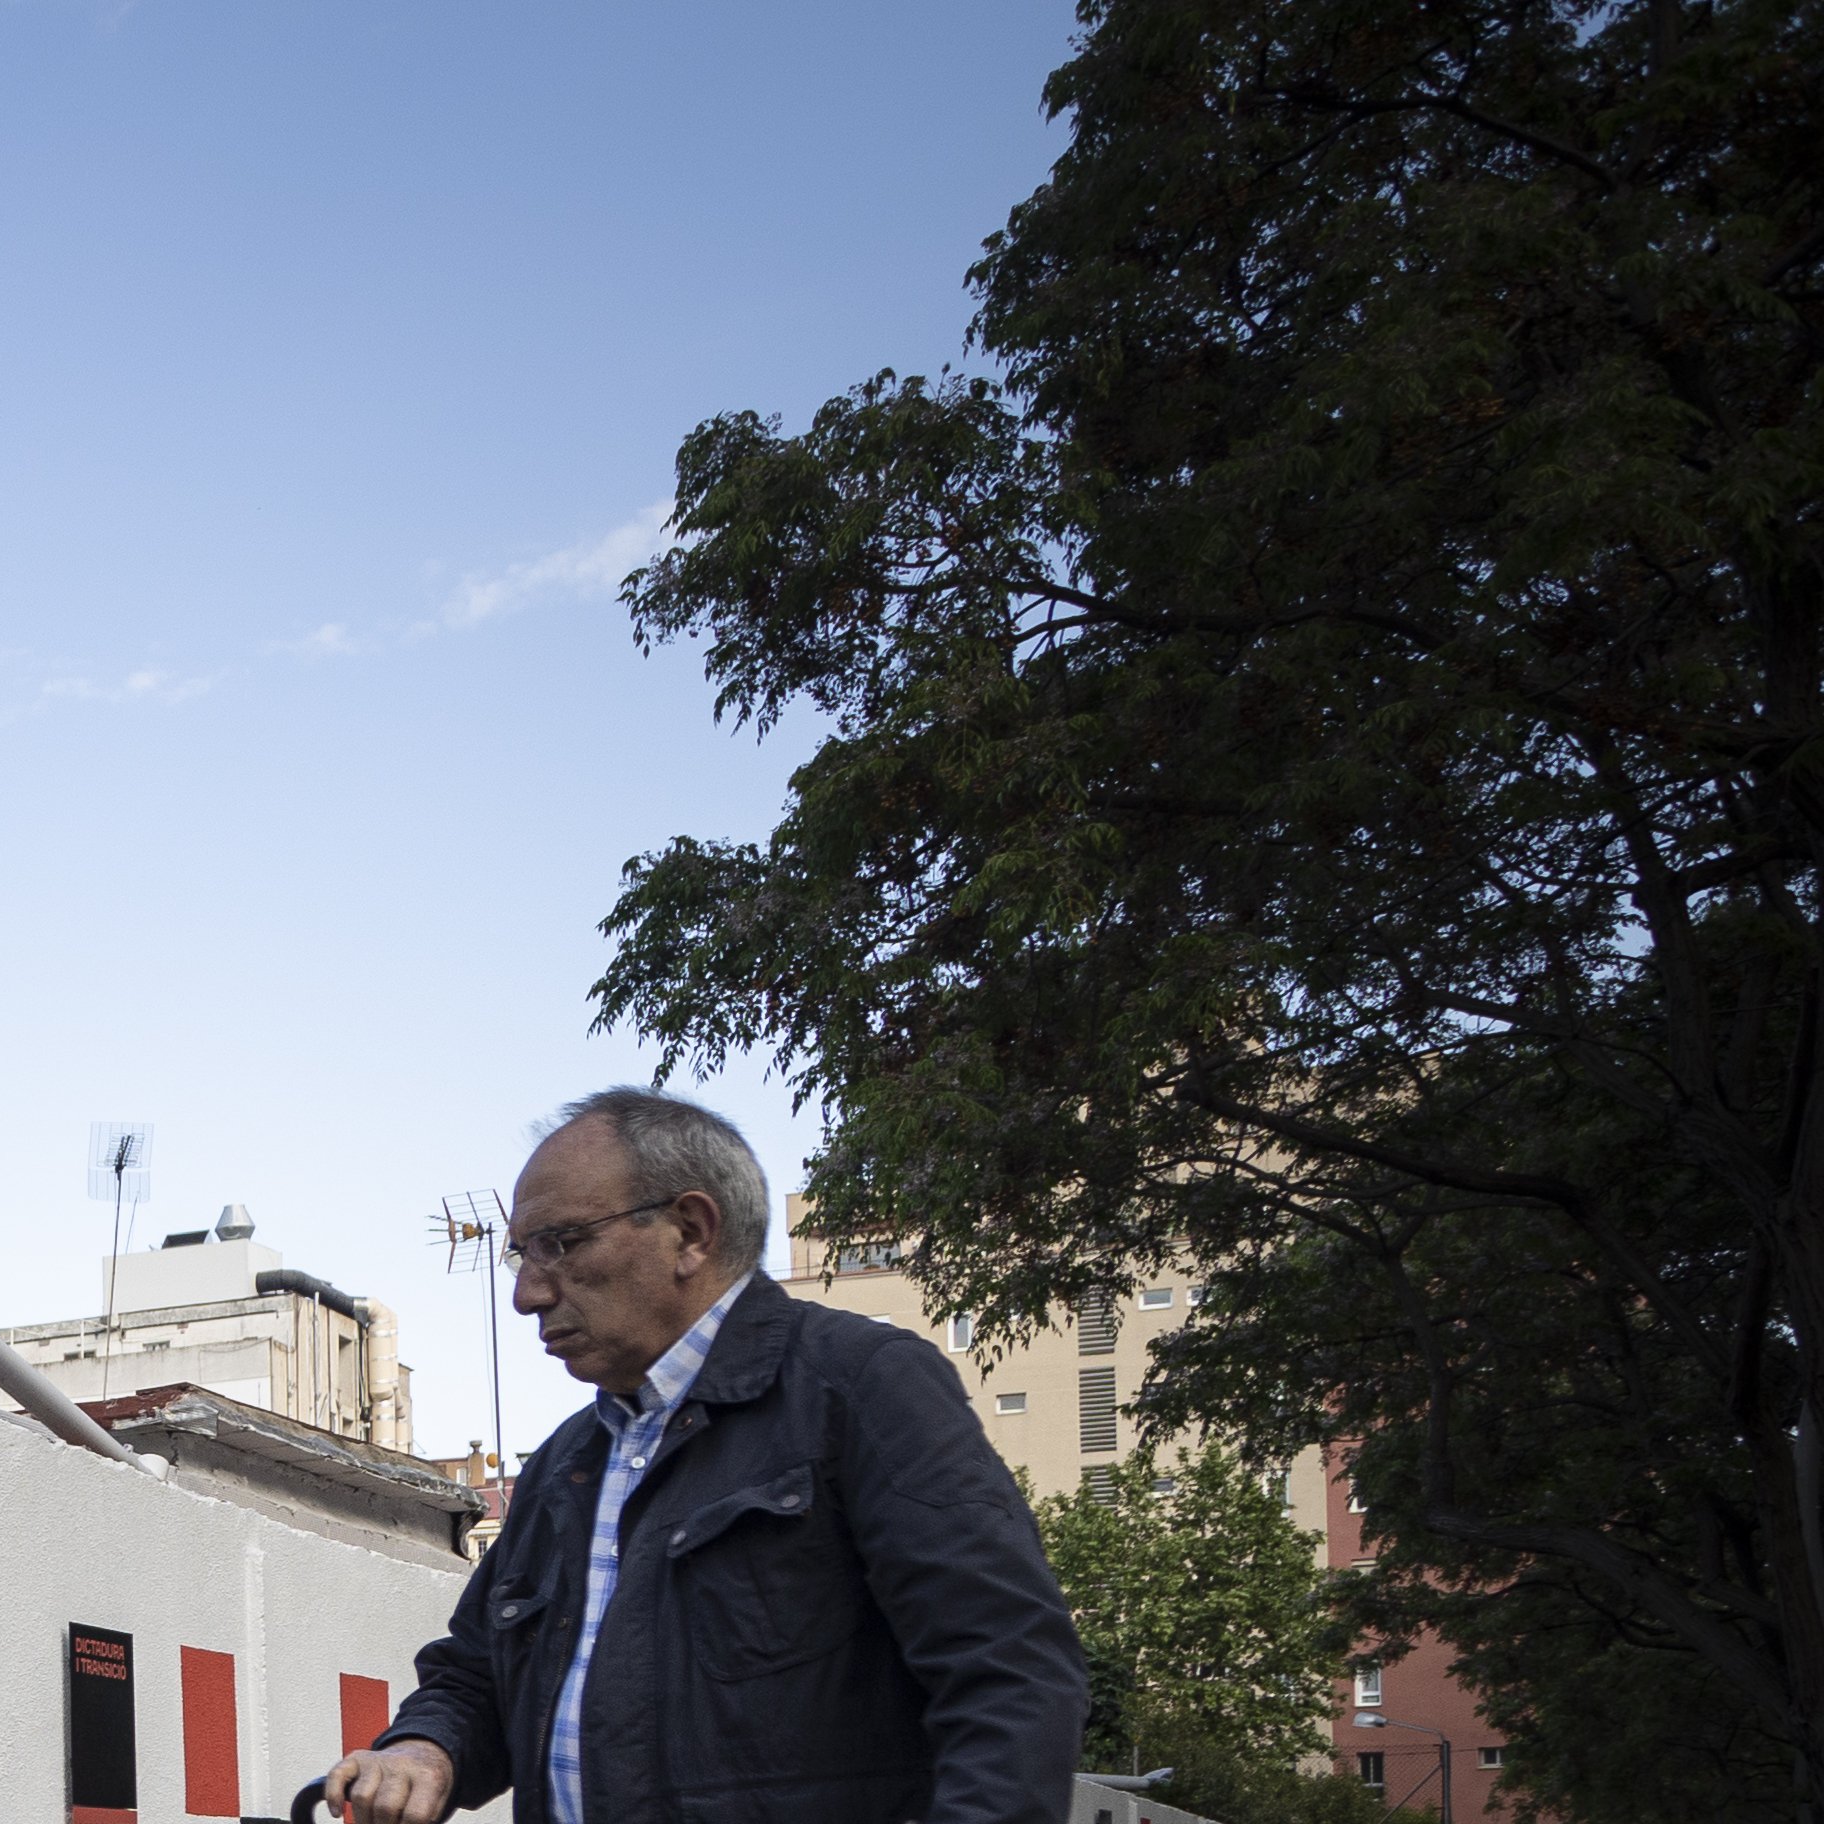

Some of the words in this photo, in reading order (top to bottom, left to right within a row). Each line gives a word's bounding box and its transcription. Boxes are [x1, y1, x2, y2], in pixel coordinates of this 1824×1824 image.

[75, 1637, 125, 1660] DICTADURA
[75, 1657, 80, 1673] I
[80, 1657, 127, 1680] TRANSICIÓ
